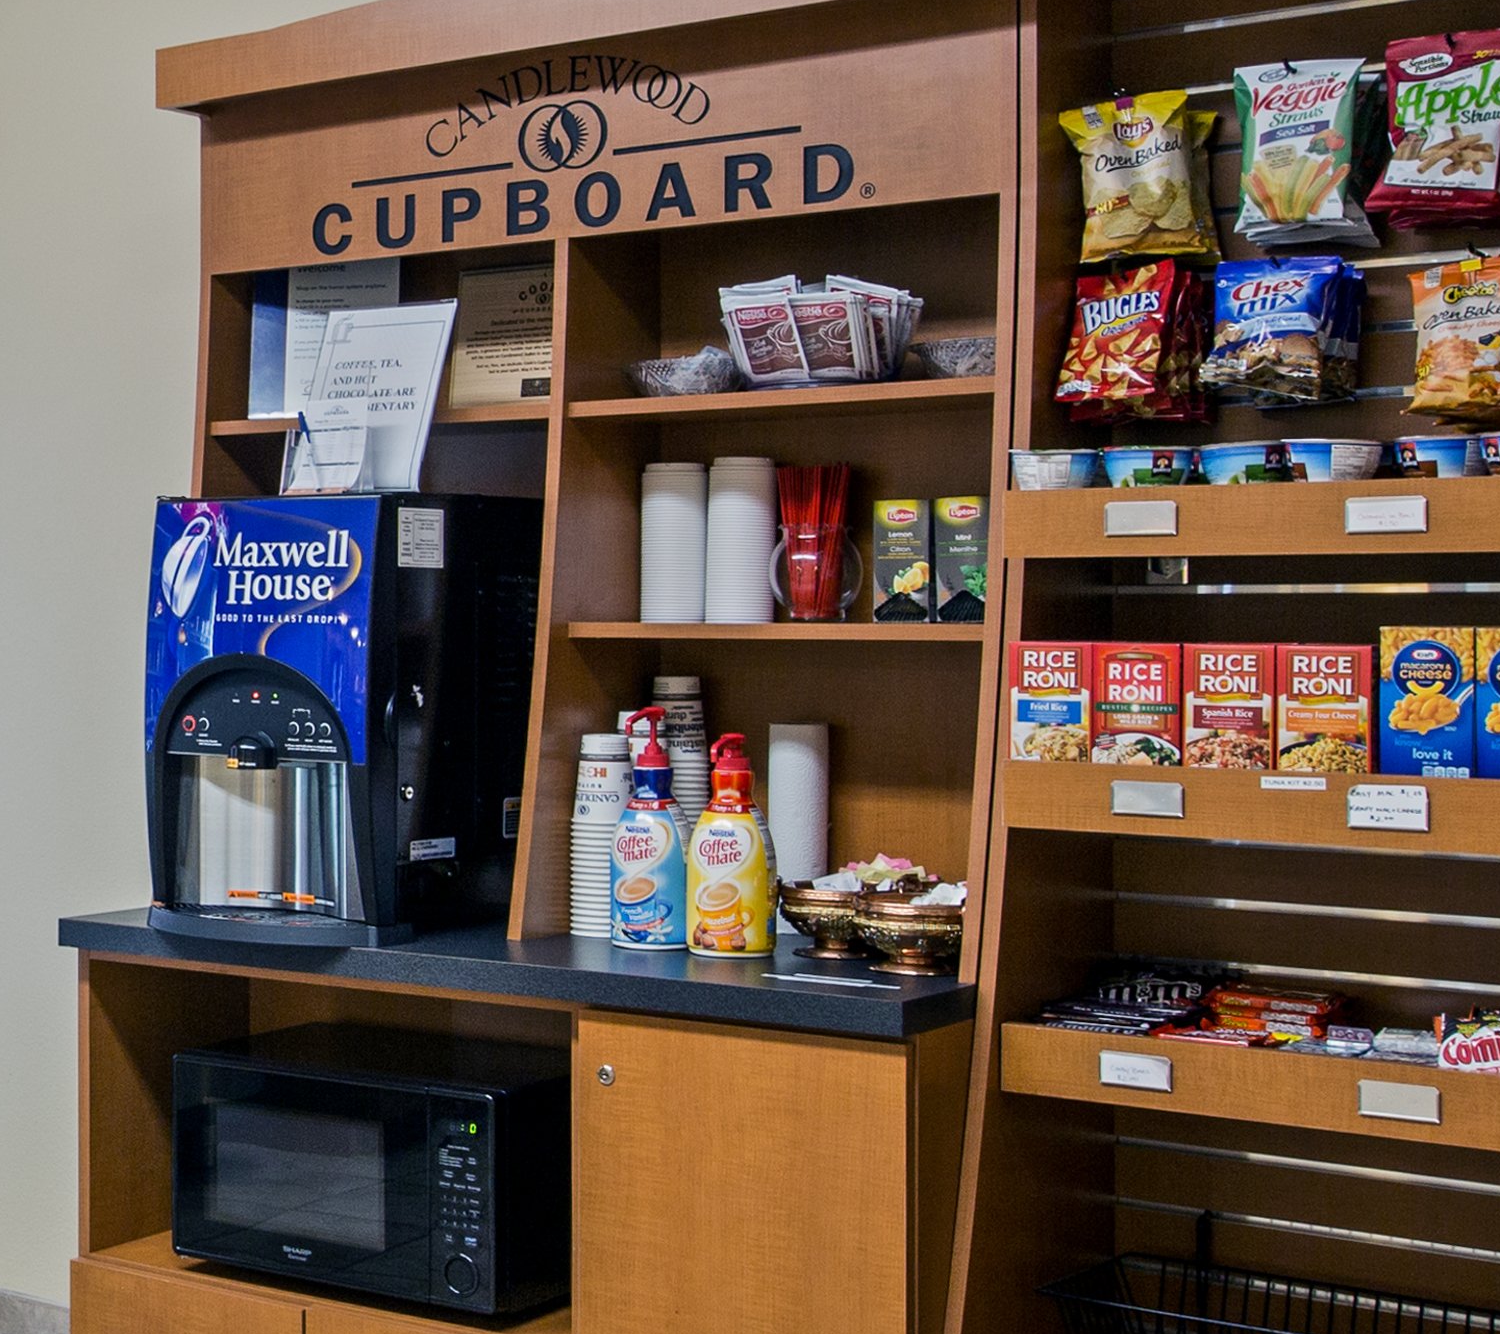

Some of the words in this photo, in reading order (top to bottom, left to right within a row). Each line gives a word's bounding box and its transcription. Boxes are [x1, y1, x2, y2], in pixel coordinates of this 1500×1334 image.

[424, 54, 712, 158] CANDLEWOOD
[1252, 80, 1347, 118] Veggie
[1275, 128, 1296, 139] Sea
[1298, 124, 1316, 135] Salt
[311, 142, 856, 256] CUPBOARD
[1231, 272, 1310, 302] Chex
[1234, 290, 1302, 317] mix
[1081, 290, 1161, 337] BUGLES
[331, 375, 353, 386] AND
[395, 387, 417, 398] ARE
[888, 508, 916, 523] Lipton
[887, 531, 914, 539] Lemon
[212, 529, 350, 569] Maxwell
[225, 570, 333, 607] House
[215, 613, 239, 623] GOOD
[242, 613, 254, 623] TO
[257, 613, 275, 624] THE
[278, 613, 302, 624] LAST
[1022, 650, 1076, 668] RICE
[1199, 653, 1258, 672] RICE
[1416, 651, 1435, 659] Kraft
[1107, 662, 1163, 681] RICE
[1292, 655, 1354, 674] RICE
[1399, 661, 1445, 671] macaroni
[1029, 702, 1050, 712] Fried
[1050, 703, 1069, 713] Rice
[1140, 705, 1174, 713] RECIPES
[1201, 707, 1233, 719] Spanish
[1234, 708, 1254, 718] Rice
[1287, 710, 1314, 720] Creamy
[1331, 711, 1358, 720] Cheese
[1412, 747, 1441, 761] love
[1443, 748, 1454, 761] it
[1263, 779, 1287, 787] TUNA
[1287, 779, 1300, 787] KIT
[623, 846, 658, 863] mate
[707, 850, 742, 867] mate
[282, 1244, 313, 1256] SHARP
